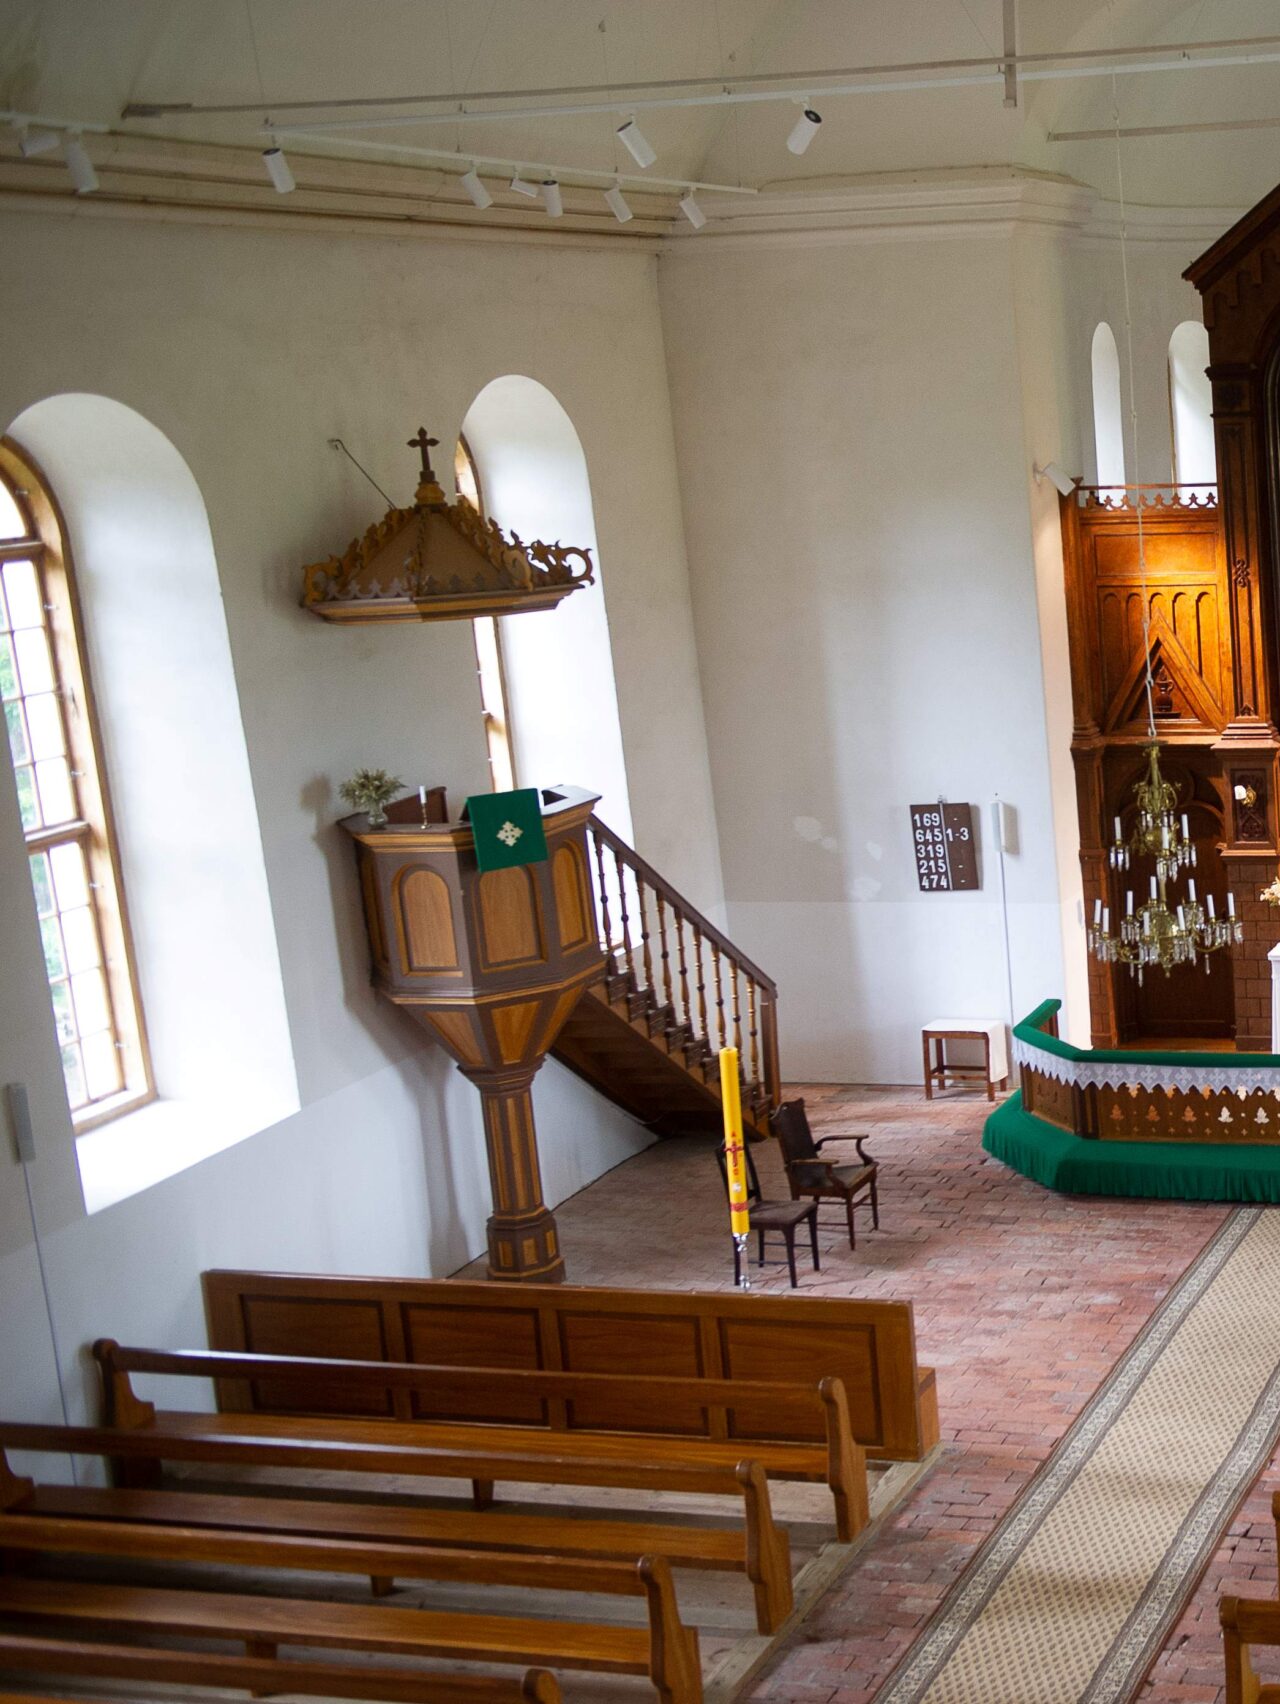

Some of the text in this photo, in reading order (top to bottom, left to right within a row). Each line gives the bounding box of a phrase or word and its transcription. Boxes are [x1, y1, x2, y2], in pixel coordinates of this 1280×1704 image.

[913, 812, 940, 827] 169
[915, 828, 942, 843] 645
[917, 844, 944, 858] 319
[919, 859, 946, 873] 215
[921, 875, 947, 889] 474
